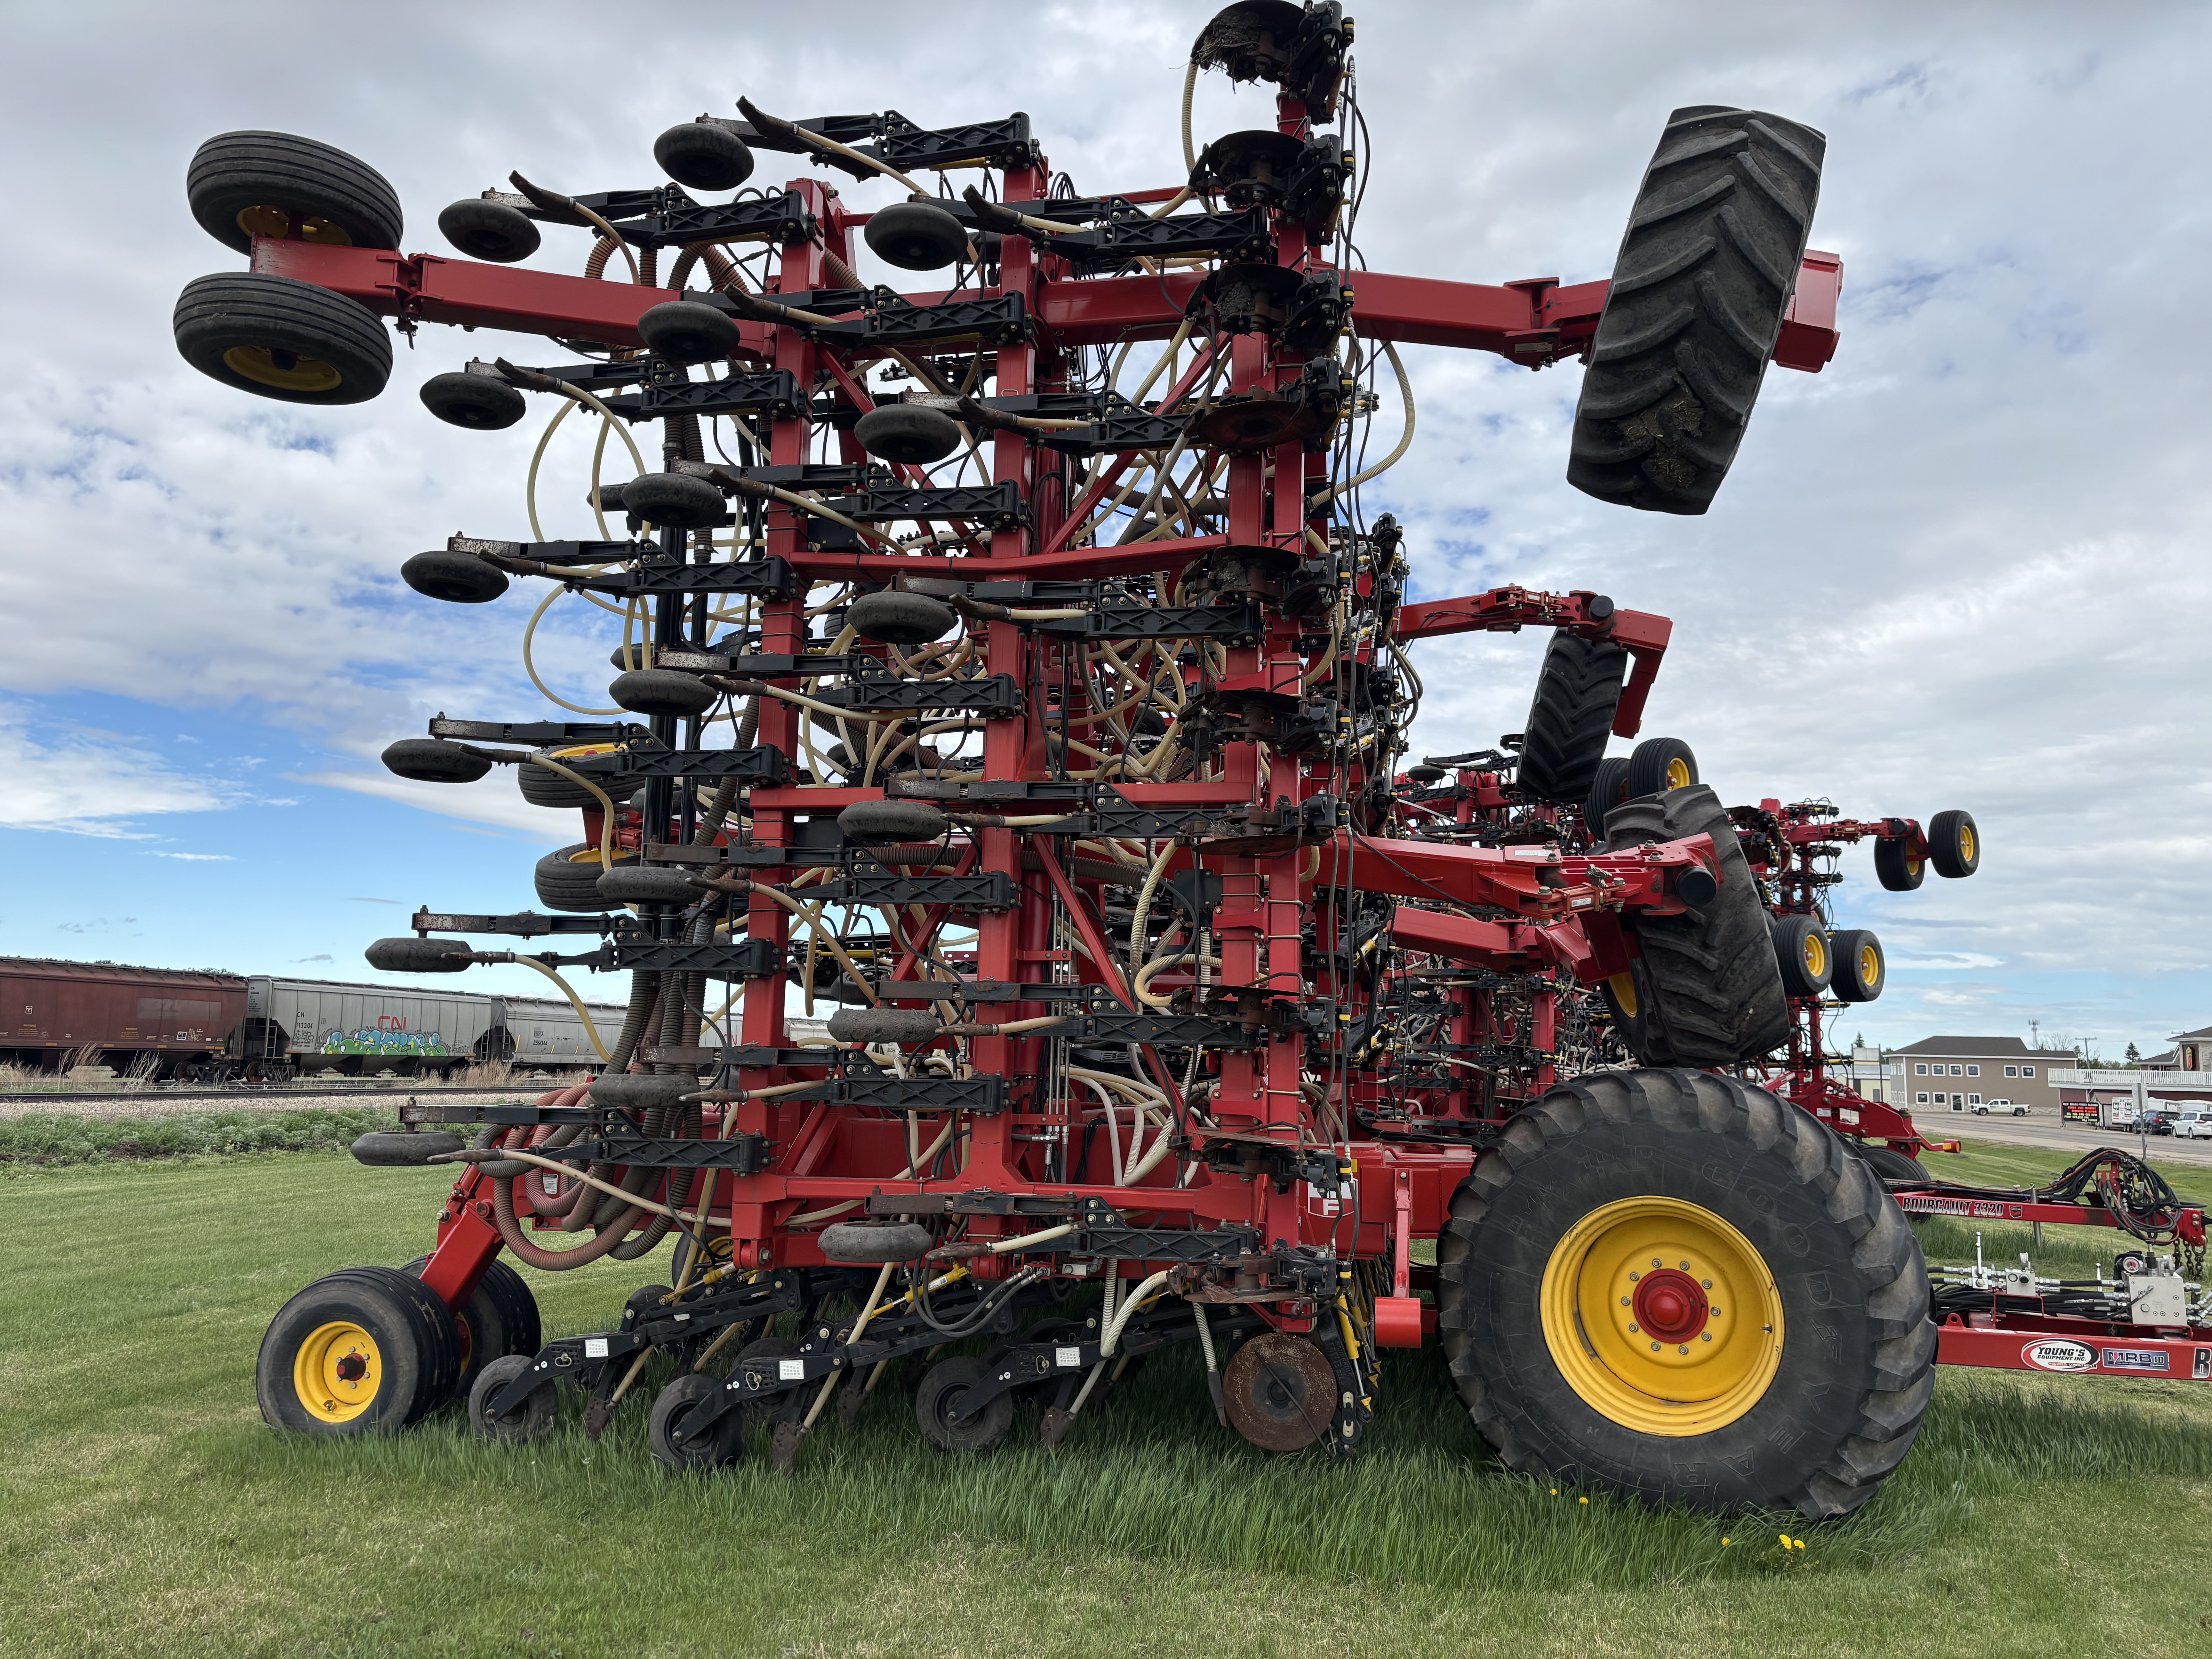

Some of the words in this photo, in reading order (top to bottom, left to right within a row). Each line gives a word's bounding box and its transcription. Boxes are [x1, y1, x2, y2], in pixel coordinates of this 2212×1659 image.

[1902, 1196, 1972, 1216] BOURGAULT
[1973, 1201, 2004, 1216] 3320
[2038, 1347, 2086, 1357] YOUNG'S
[2107, 1351, 2152, 1365] MRB
[2192, 1347, 2212, 1379] B
